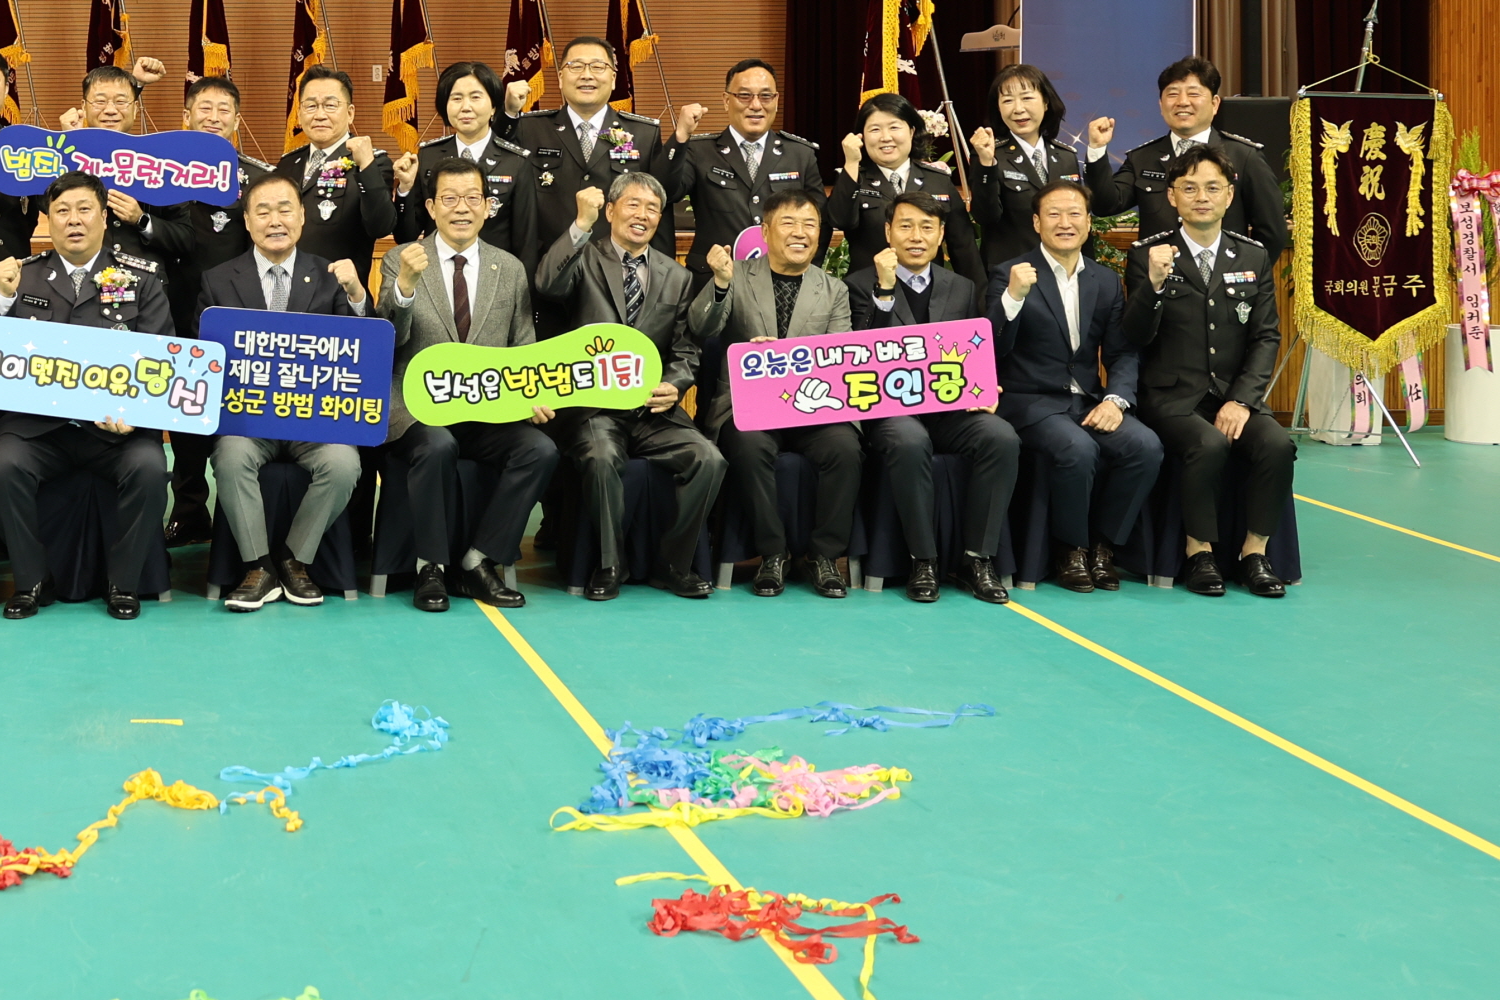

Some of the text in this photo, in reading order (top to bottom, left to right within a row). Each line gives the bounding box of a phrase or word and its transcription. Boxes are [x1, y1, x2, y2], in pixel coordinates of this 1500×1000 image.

[1358, 121, 1387, 201] 慶祝
[1459, 202, 1478, 276] 보성경찰서
[1324, 280, 1369, 297] 국회의원
[233, 330, 360, 364] 대한민국에서
[740, 336, 927, 380] 오늘은 내가 바로
[30, 355, 80, 390] 멋진
[83, 364, 139, 399] 이유,
[136, 357, 209, 417] 당신
[228, 359, 362, 393] 제일 잘나가는
[424, 351, 644, 404] 보성은 방범도 1등!
[843, 361, 968, 412] 주인공
[221, 388, 383, 425] 성군 방범 화이팅
